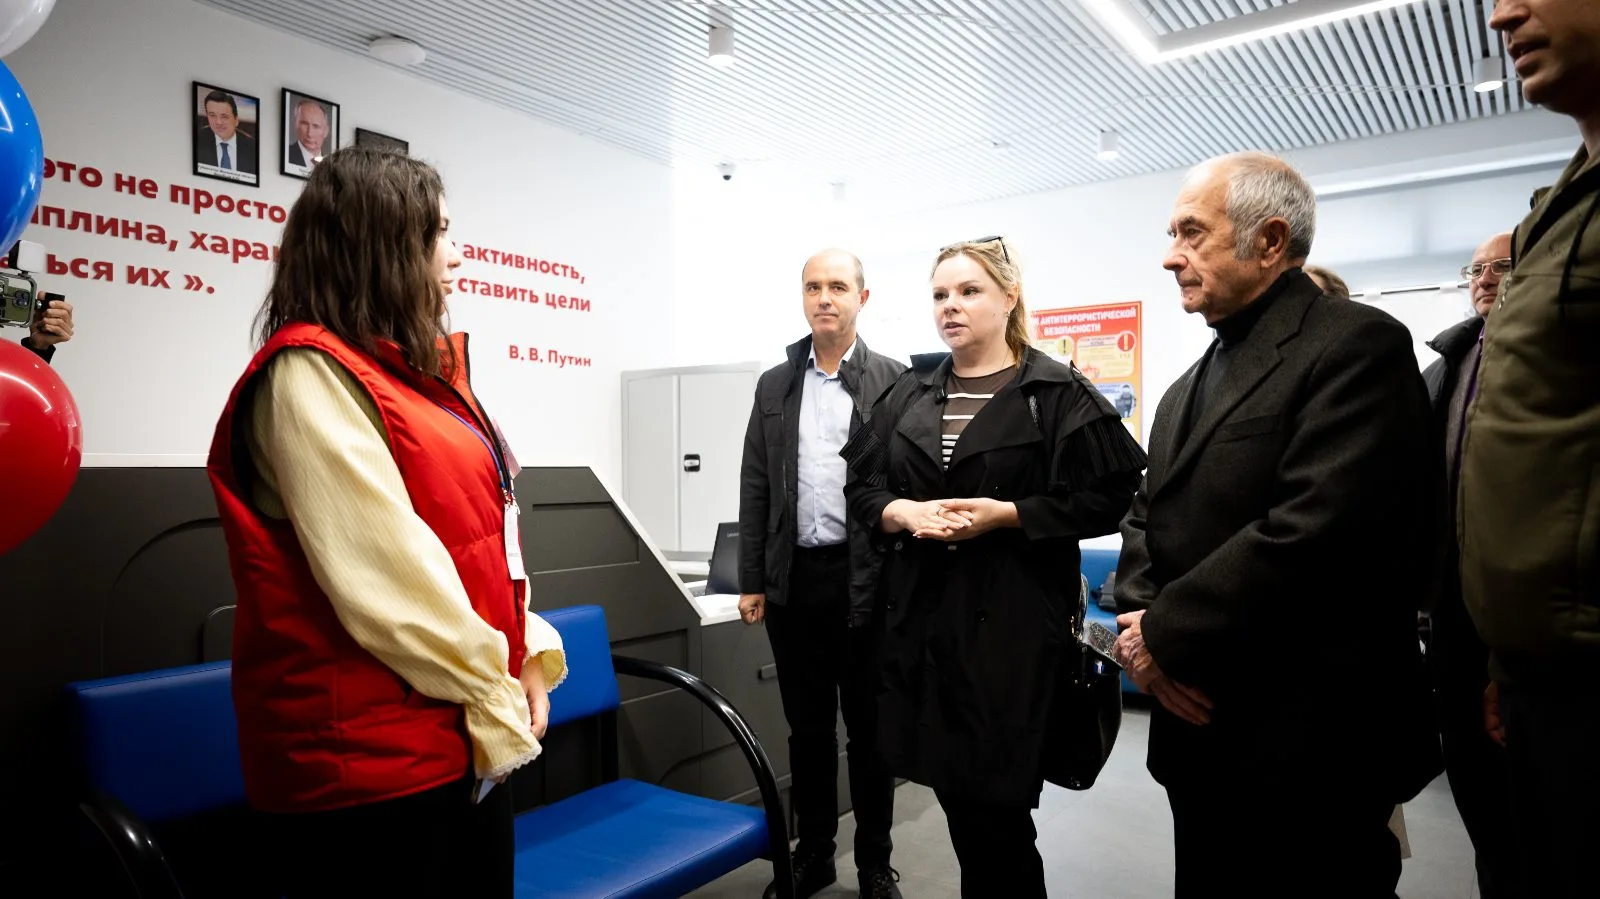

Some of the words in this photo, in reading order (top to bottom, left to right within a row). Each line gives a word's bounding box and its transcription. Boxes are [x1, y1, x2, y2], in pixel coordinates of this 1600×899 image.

[114, 172, 159, 199] не
[169, 183, 287, 224] просто
[463, 243, 586, 284] активность,
[127, 264, 172, 289] их
[457, 277, 539, 304] ставить
[545, 292, 591, 312] цели
[508, 344, 525, 361] В.
[528, 347, 544, 363] В.
[548, 349, 591, 368] Путин
